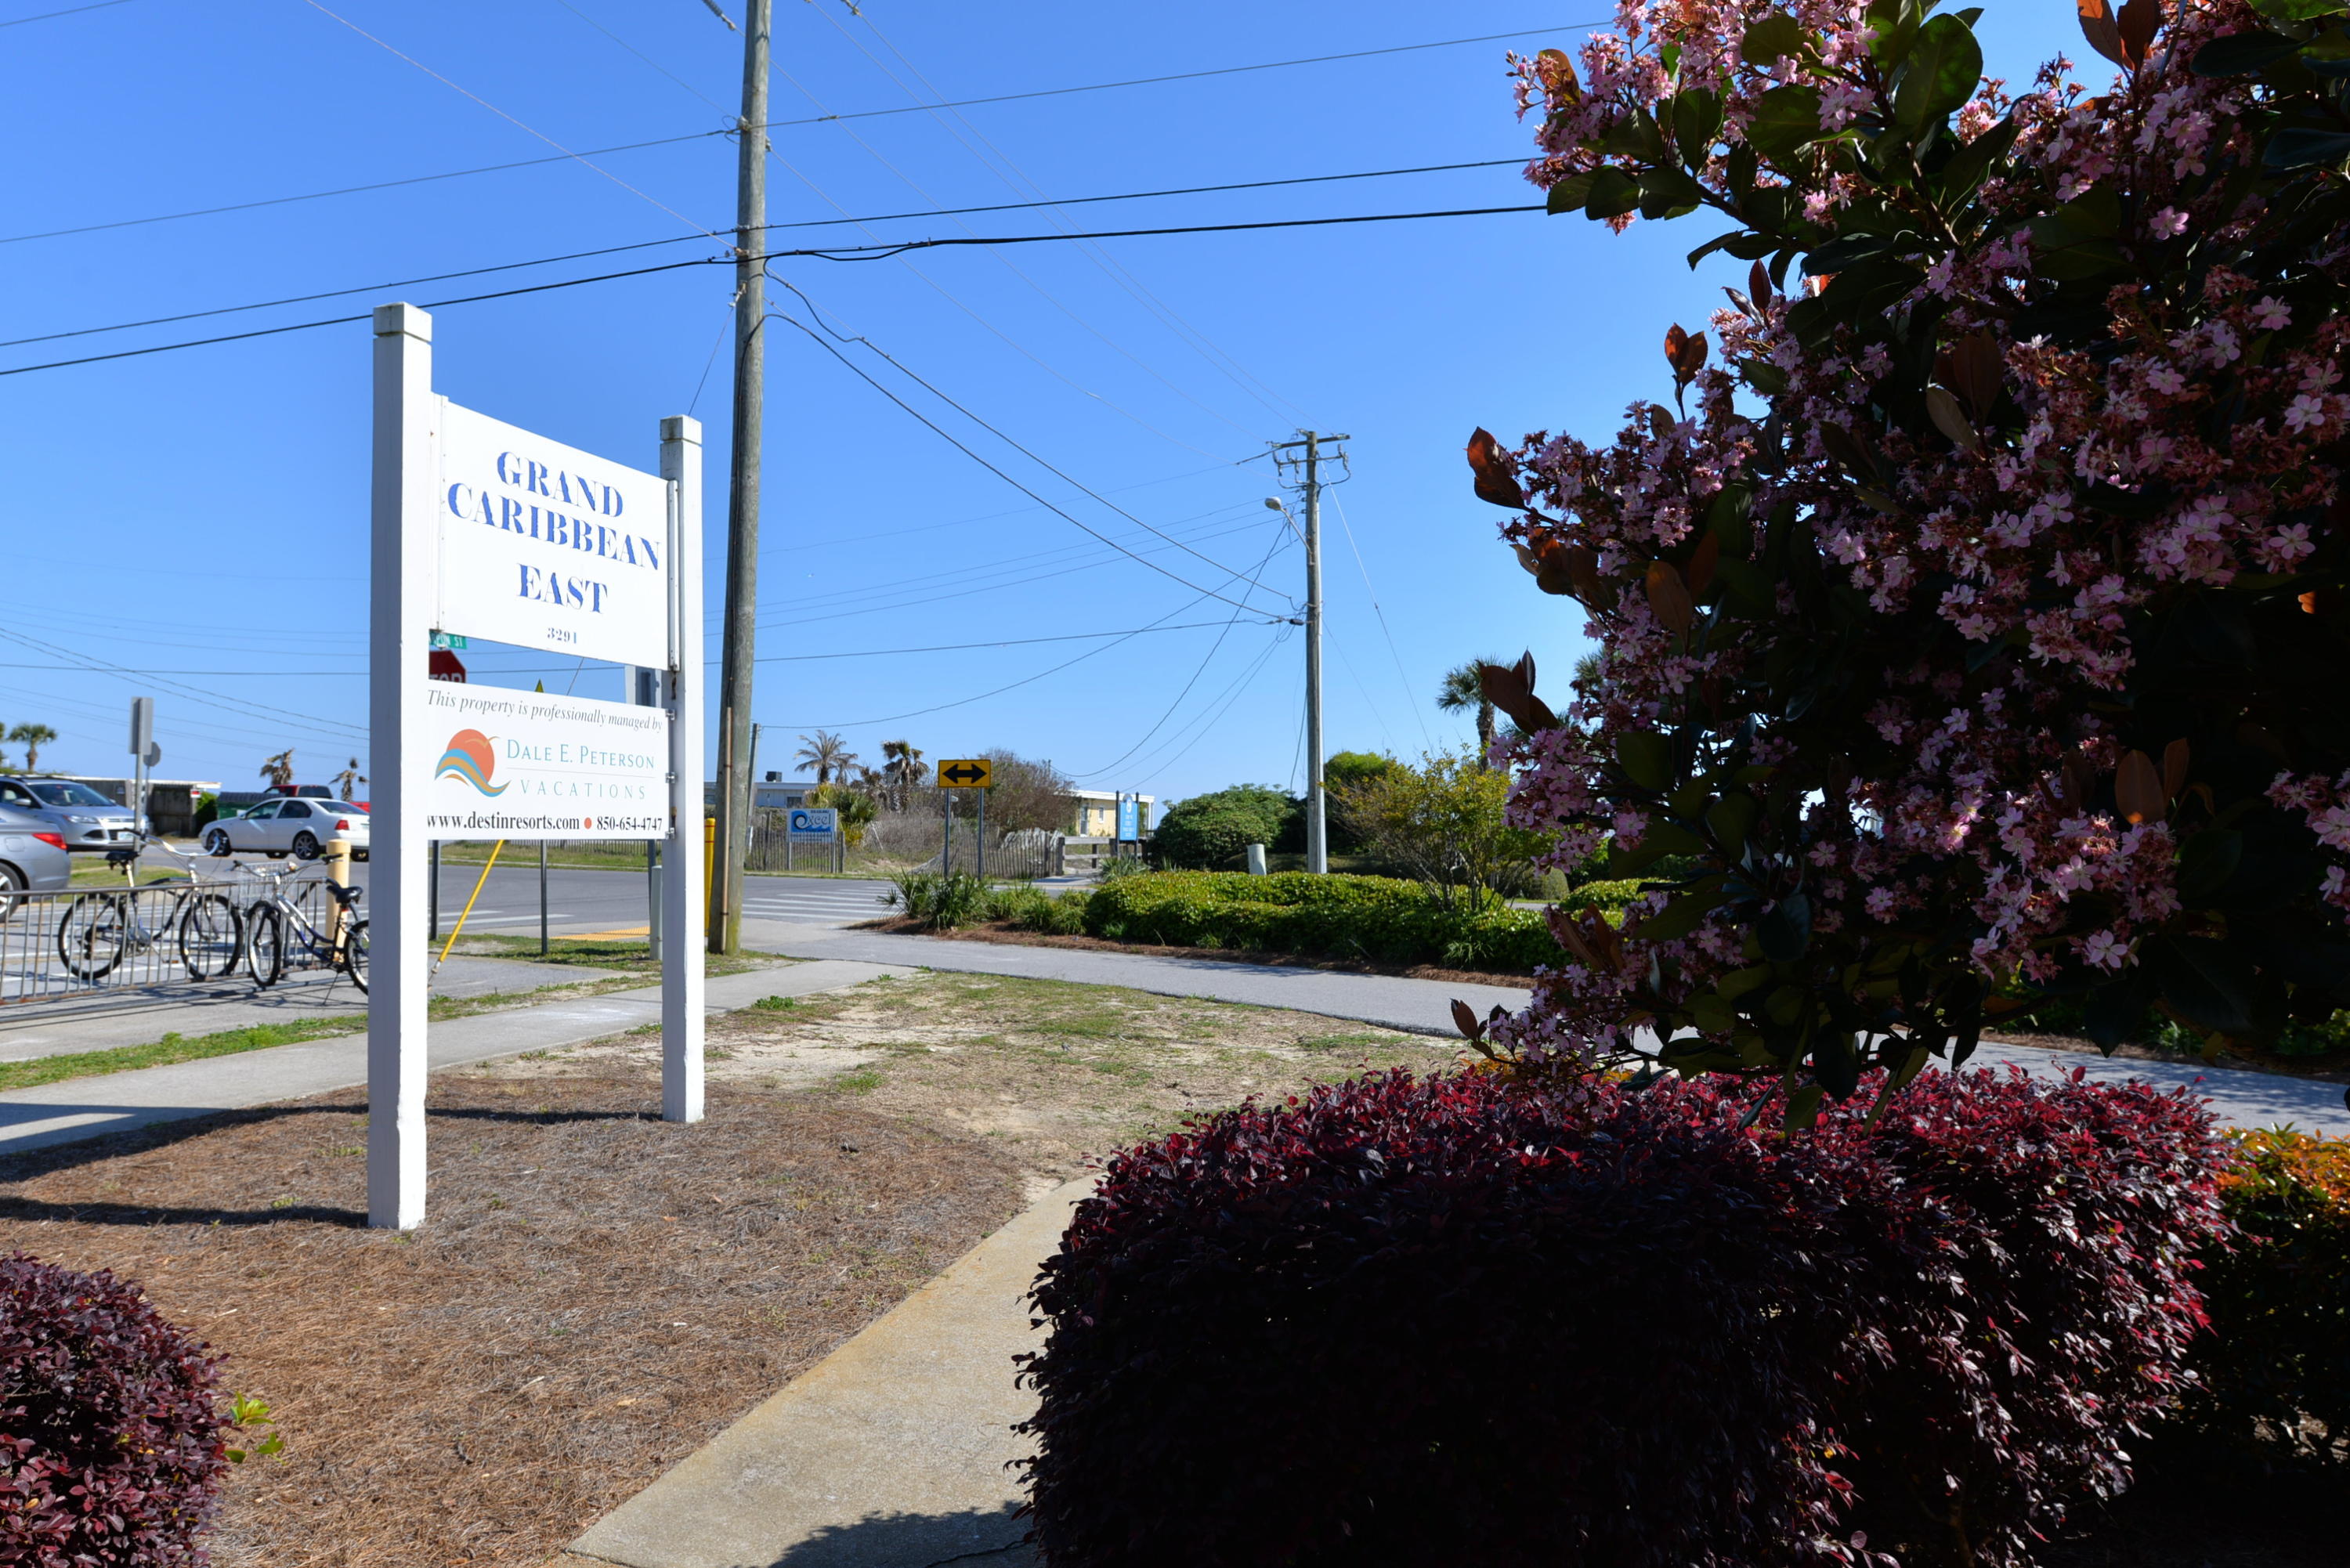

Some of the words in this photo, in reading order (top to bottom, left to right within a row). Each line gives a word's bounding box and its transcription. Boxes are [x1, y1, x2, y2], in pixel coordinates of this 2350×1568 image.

[497, 451, 624, 518] GRAND
[447, 482, 660, 570] CARIBBEAN
[516, 562, 608, 614] EAST
[547, 627, 577, 644] 3291
[428, 689, 457, 708] This
[459, 696, 515, 717] property
[518, 700, 530, 715] is
[530, 704, 606, 728] professionally
[608, 716, 650, 731] managed
[652, 720, 663, 734] by
[508, 739, 552, 761] DALE
[560, 744, 573, 763] E.
[580, 746, 655, 769] PETERSON
[520, 779, 645, 800] VACATIONS
[427, 811, 580, 829] www.destinresorts.com
[597, 816, 663, 830] 850-654-4747
